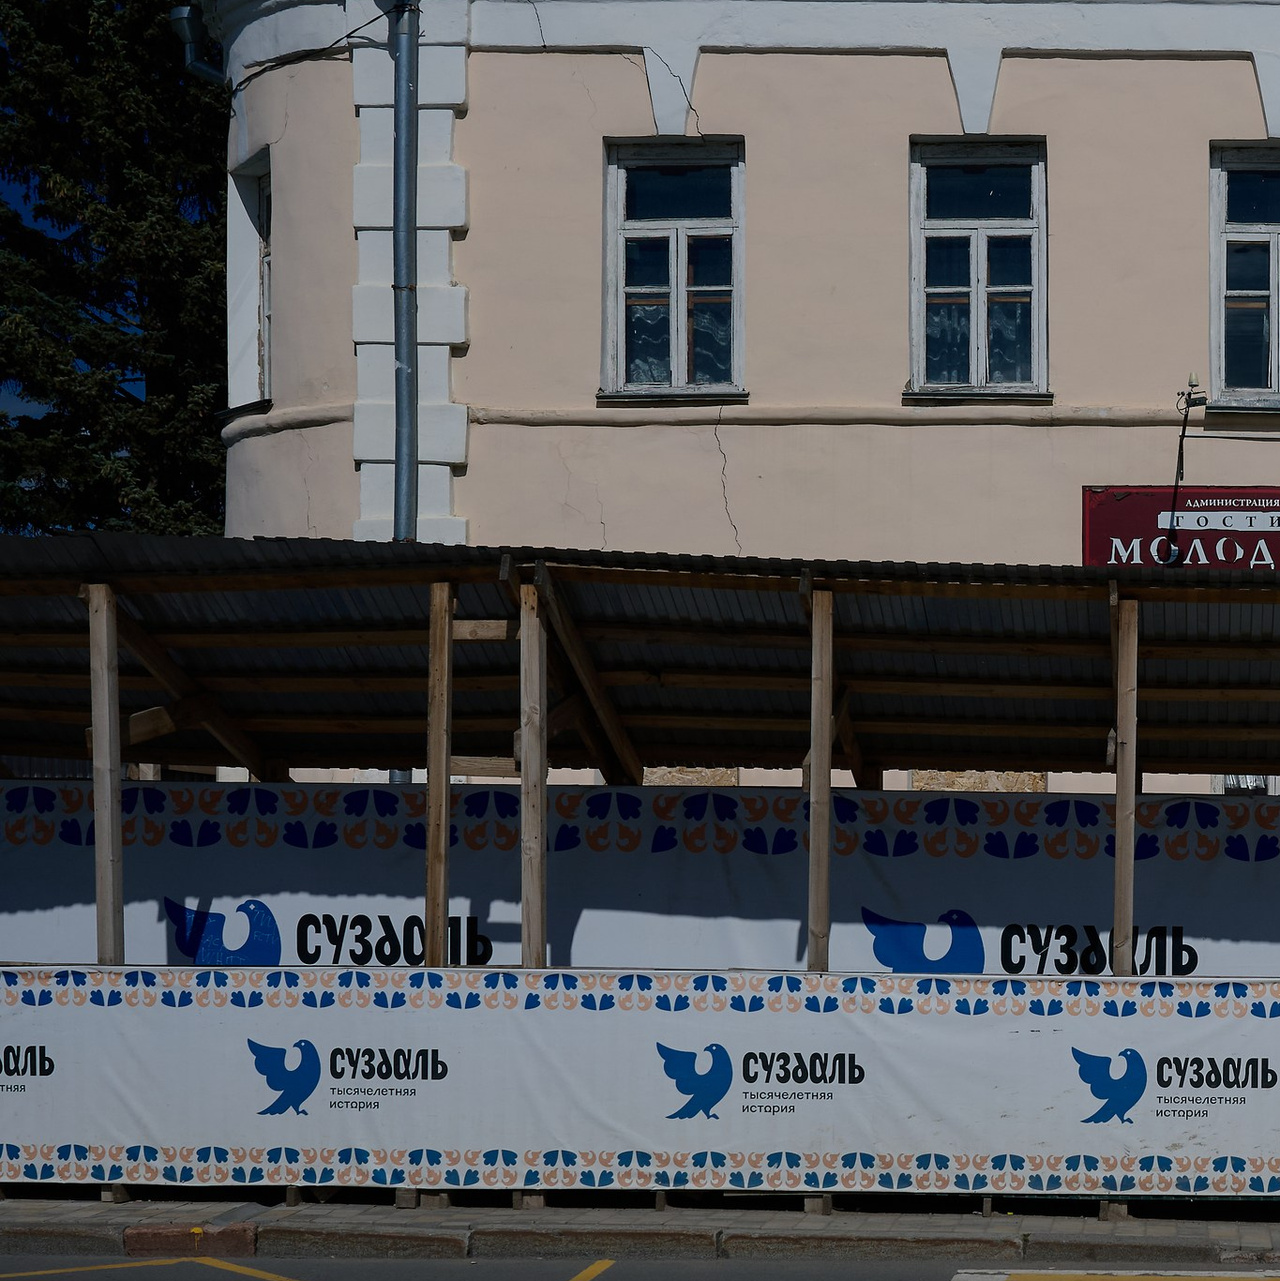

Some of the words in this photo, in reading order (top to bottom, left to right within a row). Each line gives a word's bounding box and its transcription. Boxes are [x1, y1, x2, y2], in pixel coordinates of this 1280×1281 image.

[1185, 498, 1280, 508] АДМИНИСТРАЦИЯ
[329, 1087, 417, 1097] тысячелетняя
[742, 1091, 834, 1100] тысячелетняя
[1156, 1095, 1246, 1105] тысячелетняя
[329, 1100, 380, 1112] история
[742, 1104, 796, 1116] история
[1155, 1108, 1209, 1121] история
